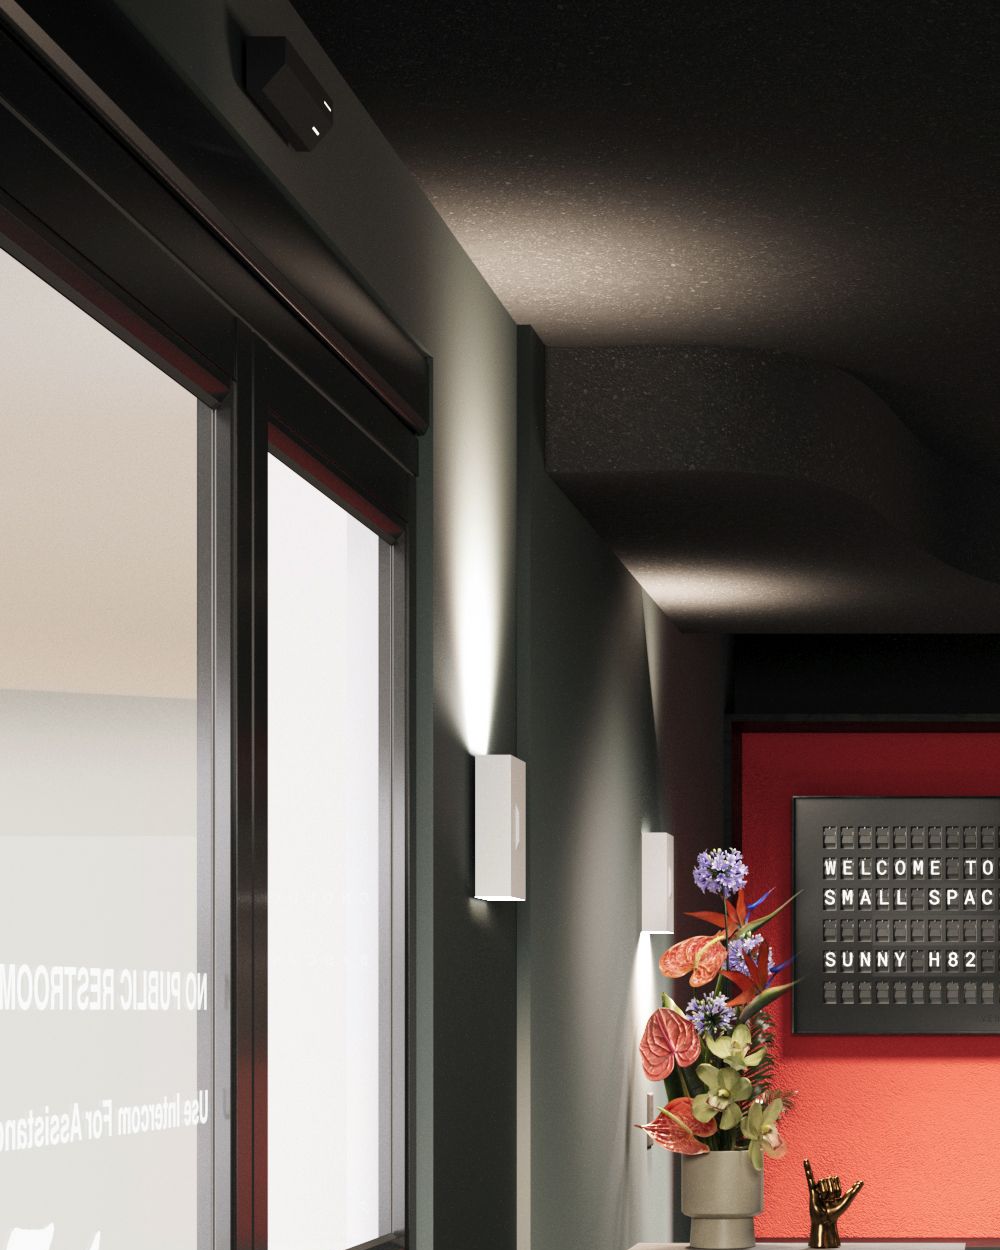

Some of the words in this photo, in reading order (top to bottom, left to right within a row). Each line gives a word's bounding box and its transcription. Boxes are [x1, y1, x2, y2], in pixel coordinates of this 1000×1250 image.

[824, 858, 942, 876] WELCOME
[965, 858, 995, 876] TO
[824, 888, 908, 906] SMALL
[824, 951, 907, 968] SUNNY
[928, 951, 977, 968] H82
